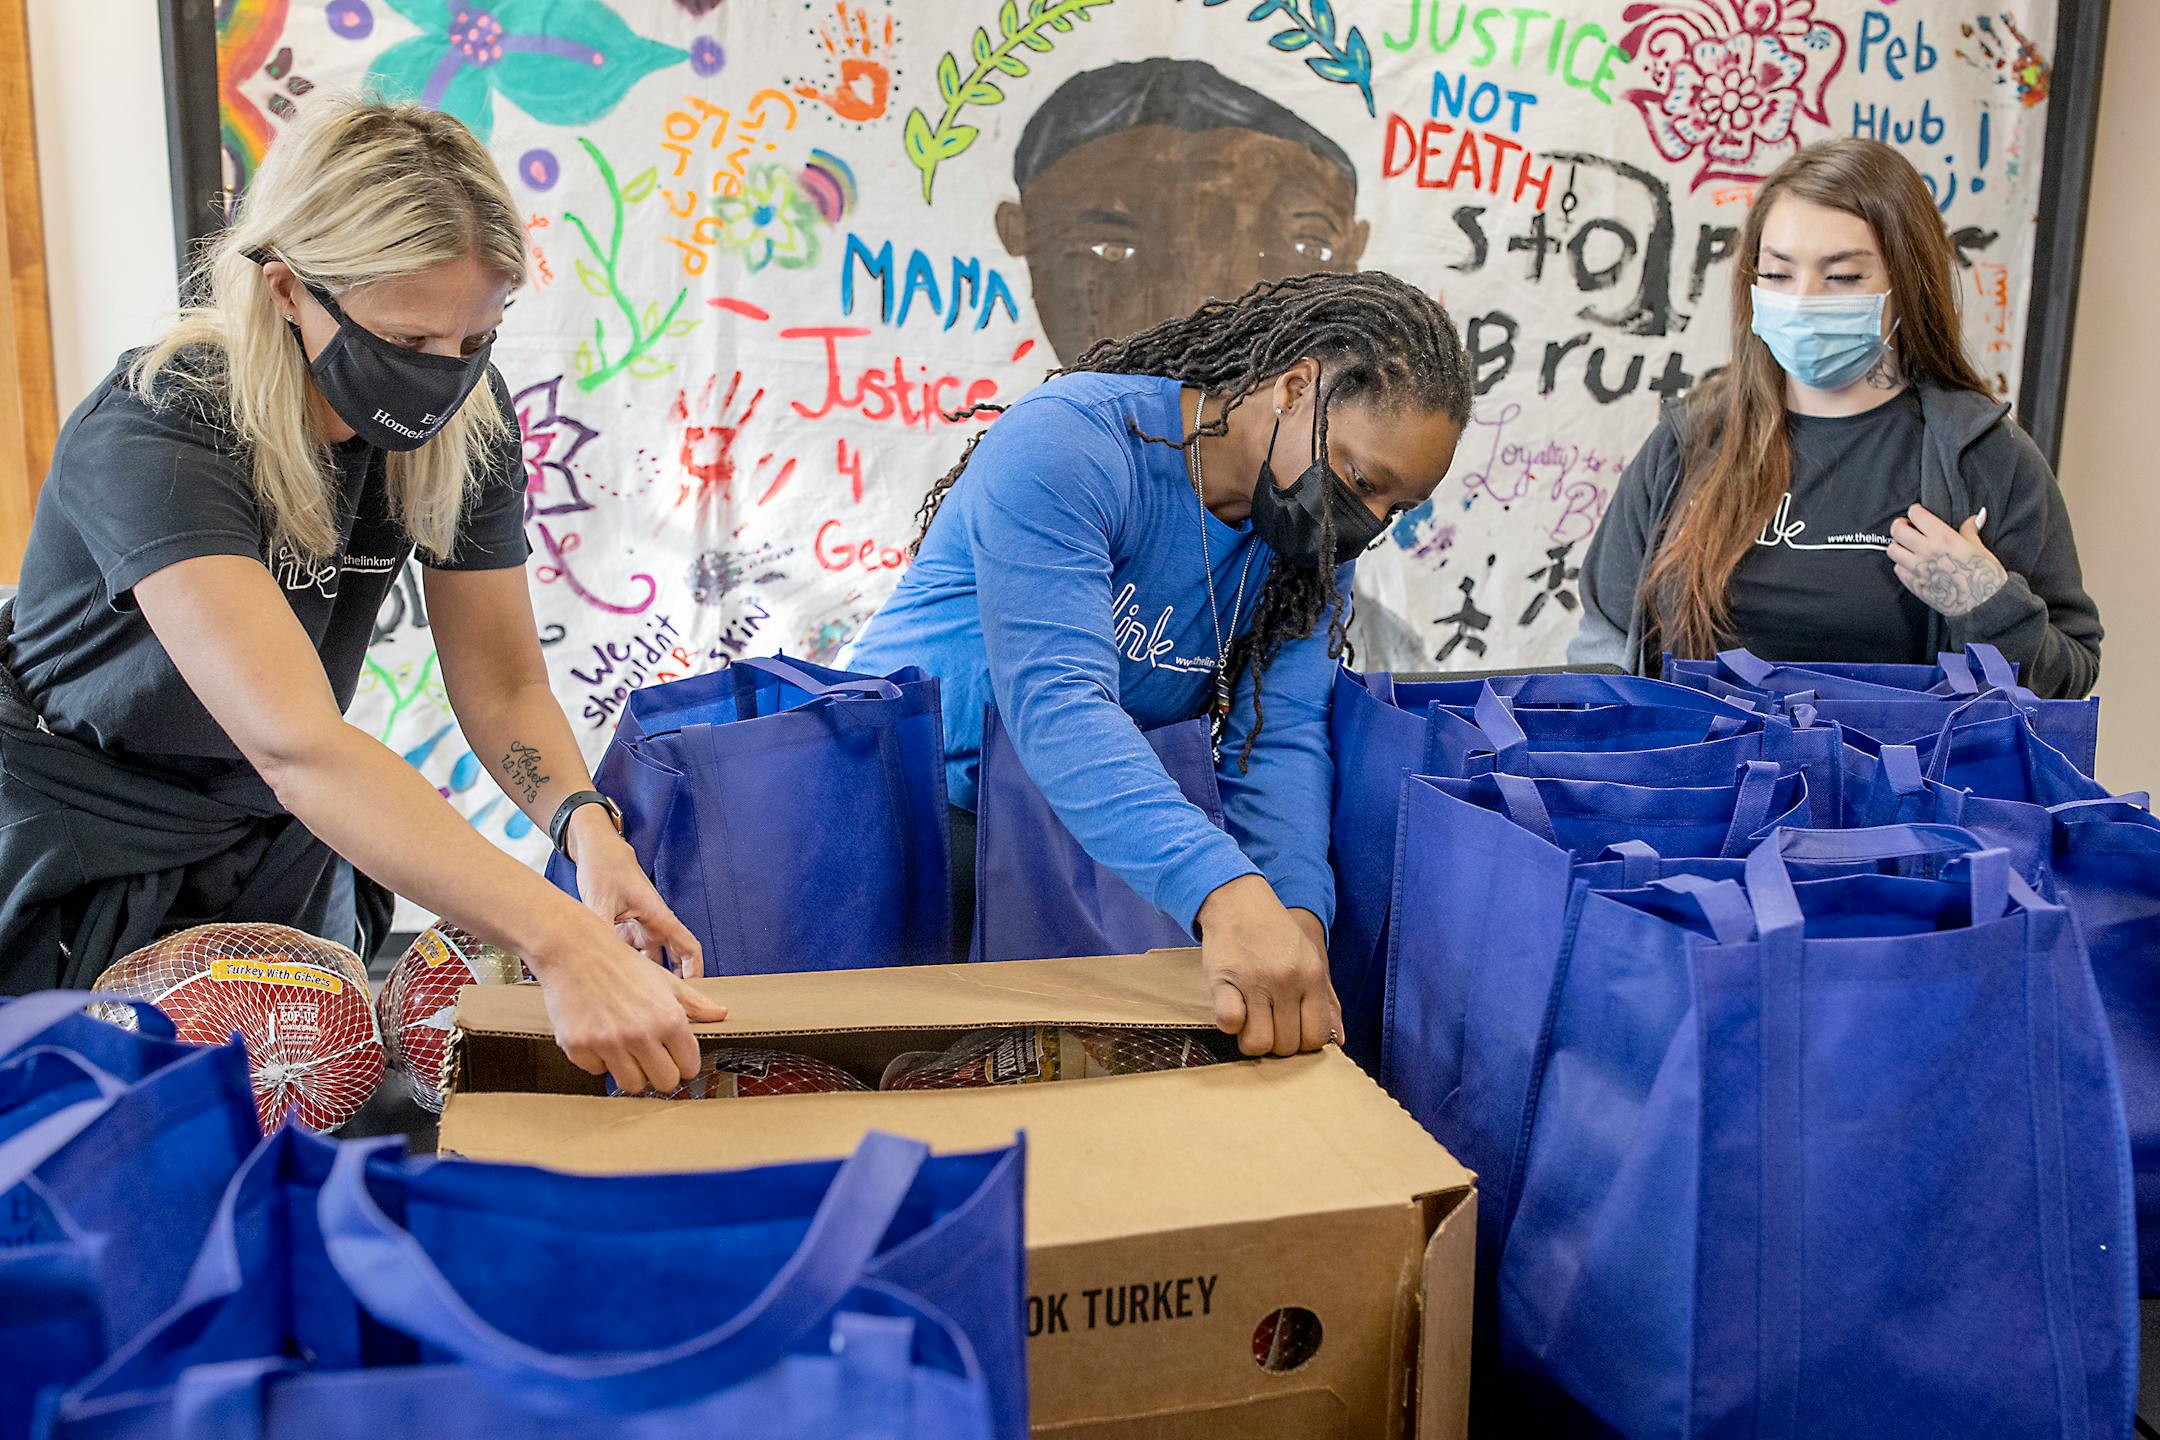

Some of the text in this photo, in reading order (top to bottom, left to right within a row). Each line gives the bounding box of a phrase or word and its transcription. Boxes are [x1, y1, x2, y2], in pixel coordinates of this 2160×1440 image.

[1383, 0, 1631, 105] JUSTICE
[1858, 11, 1937, 81] Peb
[1431, 71, 1538, 133] NOT
[1383, 112, 1553, 211] DEATH
[841, 232, 1019, 332] MAMA
[1467, 309, 1730, 405] Brut
[371, 408, 424, 440] Homel
[838, 438, 863, 504] 4
[570, 642, 631, 686] We
[226, 964, 331, 987] Turkey With Giblets
[1082, 1273, 1218, 1329] TURKEY
